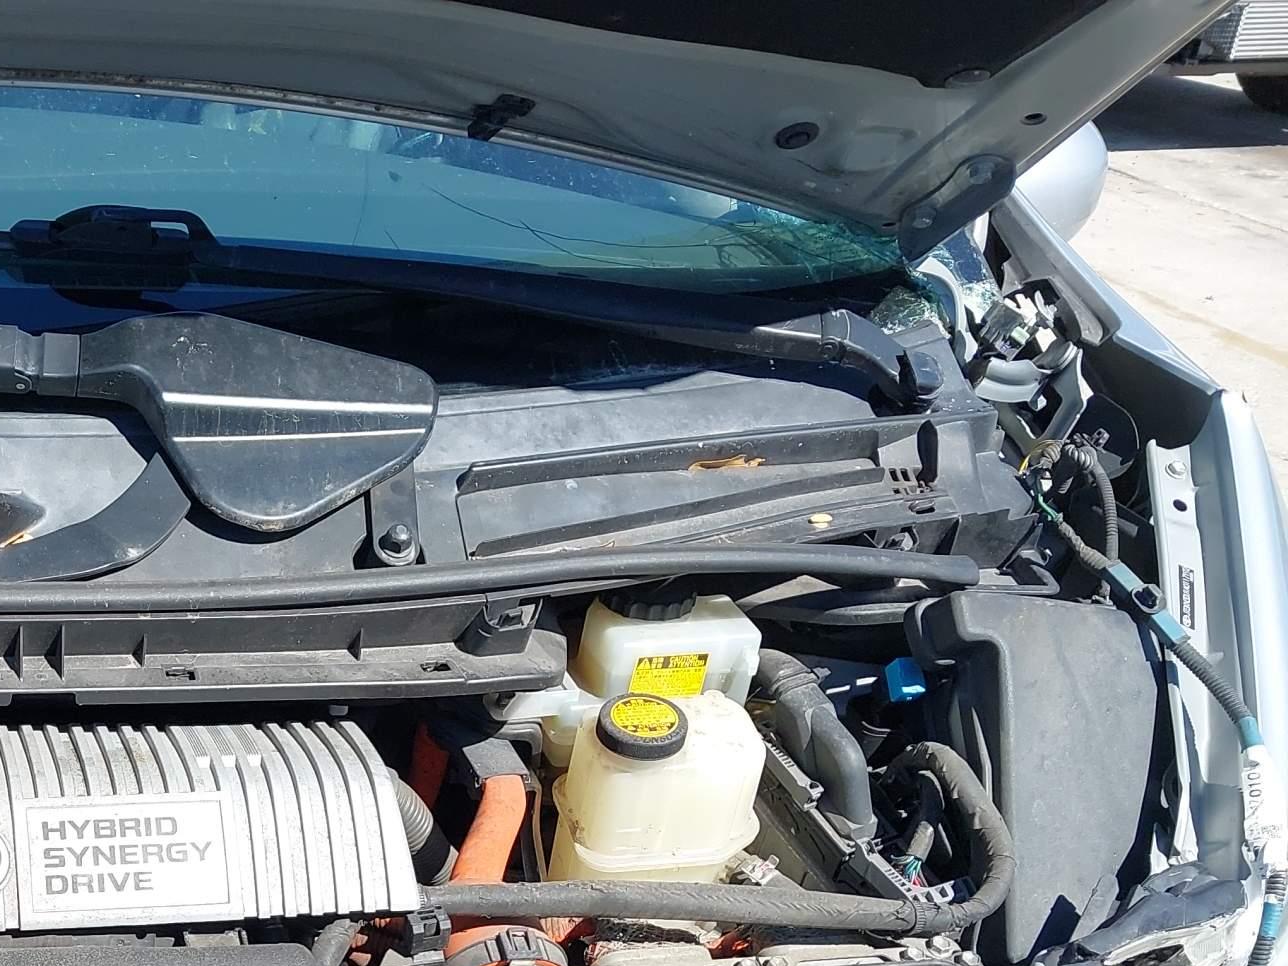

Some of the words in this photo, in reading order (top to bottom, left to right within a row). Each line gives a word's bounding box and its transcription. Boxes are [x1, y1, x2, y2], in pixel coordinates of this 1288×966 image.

[41, 816, 178, 841] HYBRID
[43, 841, 212, 868] SYNERGY
[45, 871, 155, 896] DRIVE
